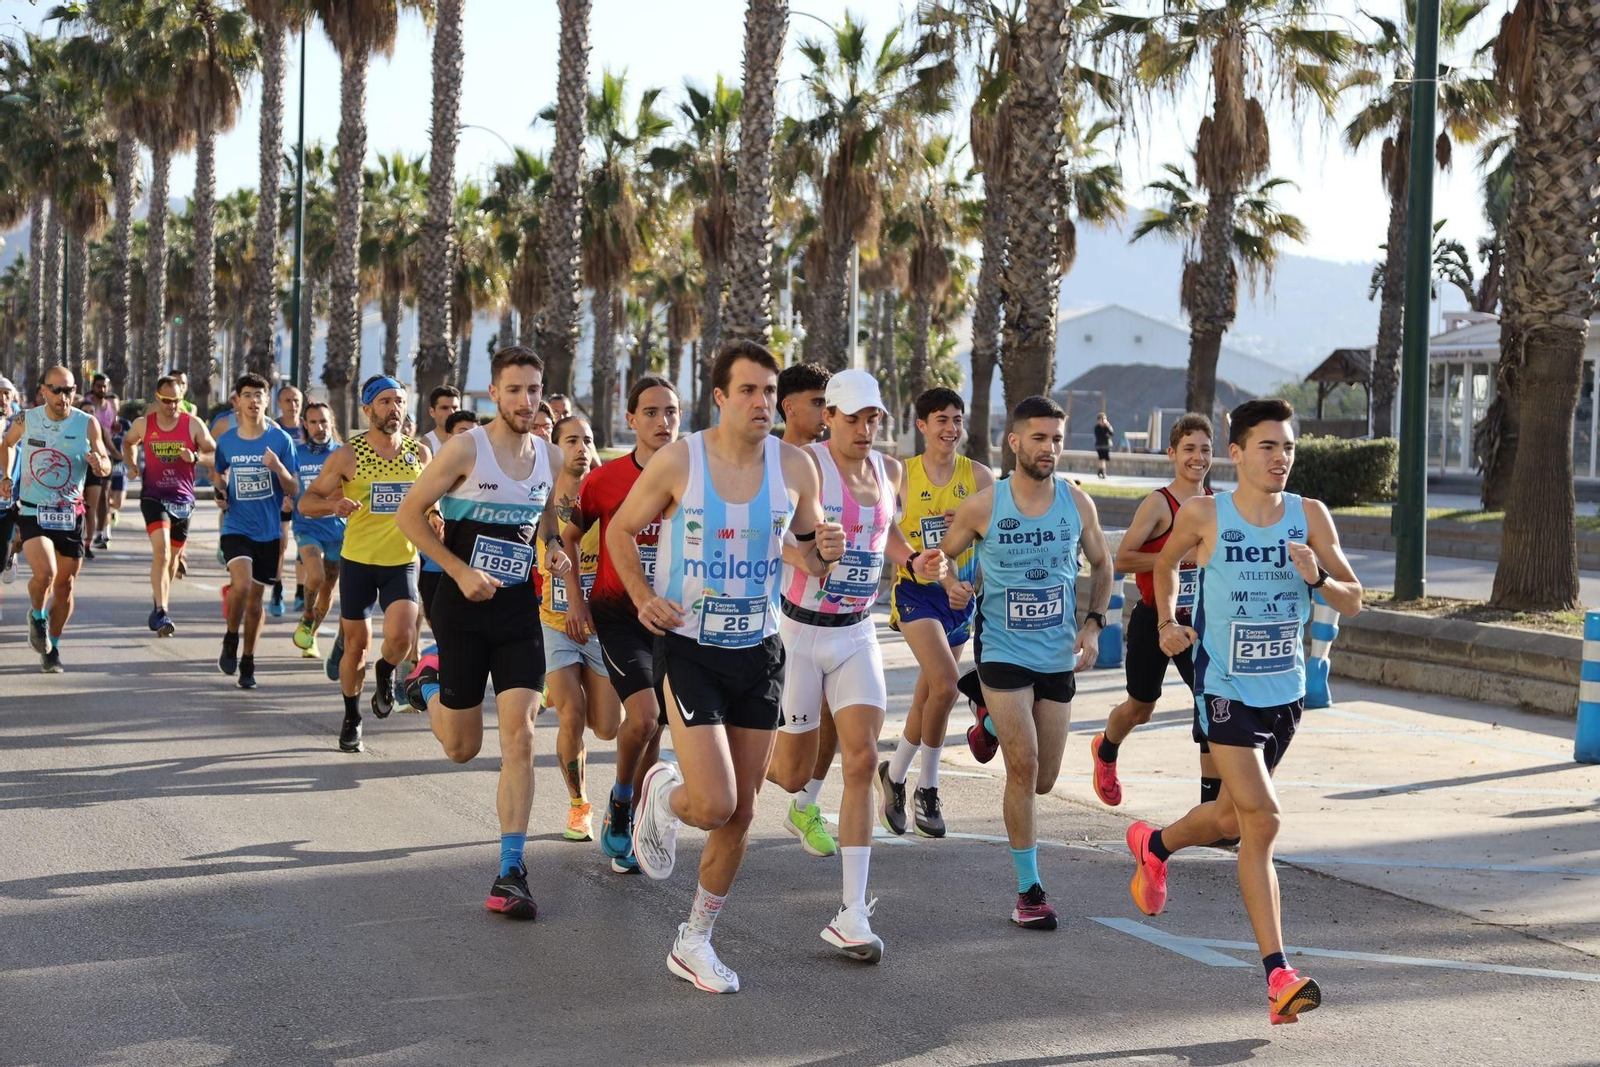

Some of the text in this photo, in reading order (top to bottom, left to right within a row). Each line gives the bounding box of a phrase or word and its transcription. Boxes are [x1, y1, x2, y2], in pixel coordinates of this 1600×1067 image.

[240, 481, 267, 490] 2210
[478, 482, 499, 491] vive
[376, 494, 406, 503] 205
[684, 508, 704, 516] vive
[824, 505, 843, 513] vive
[42, 513, 71, 521] 1669
[998, 518, 1020, 529] TROPS
[998, 527, 1056, 547] nerja
[1222, 531, 1245, 542] TROPS
[1007, 546, 1049, 556] ATLETISMO
[480, 554, 523, 575] 1992
[846, 568, 869, 582] 25
[1025, 568, 1048, 579] TROPS
[1238, 571, 1294, 580] ATLETISMO
[1014, 601, 1057, 617] 1647
[723, 616, 749, 631] 26
[1240, 640, 1293, 658] 2156
